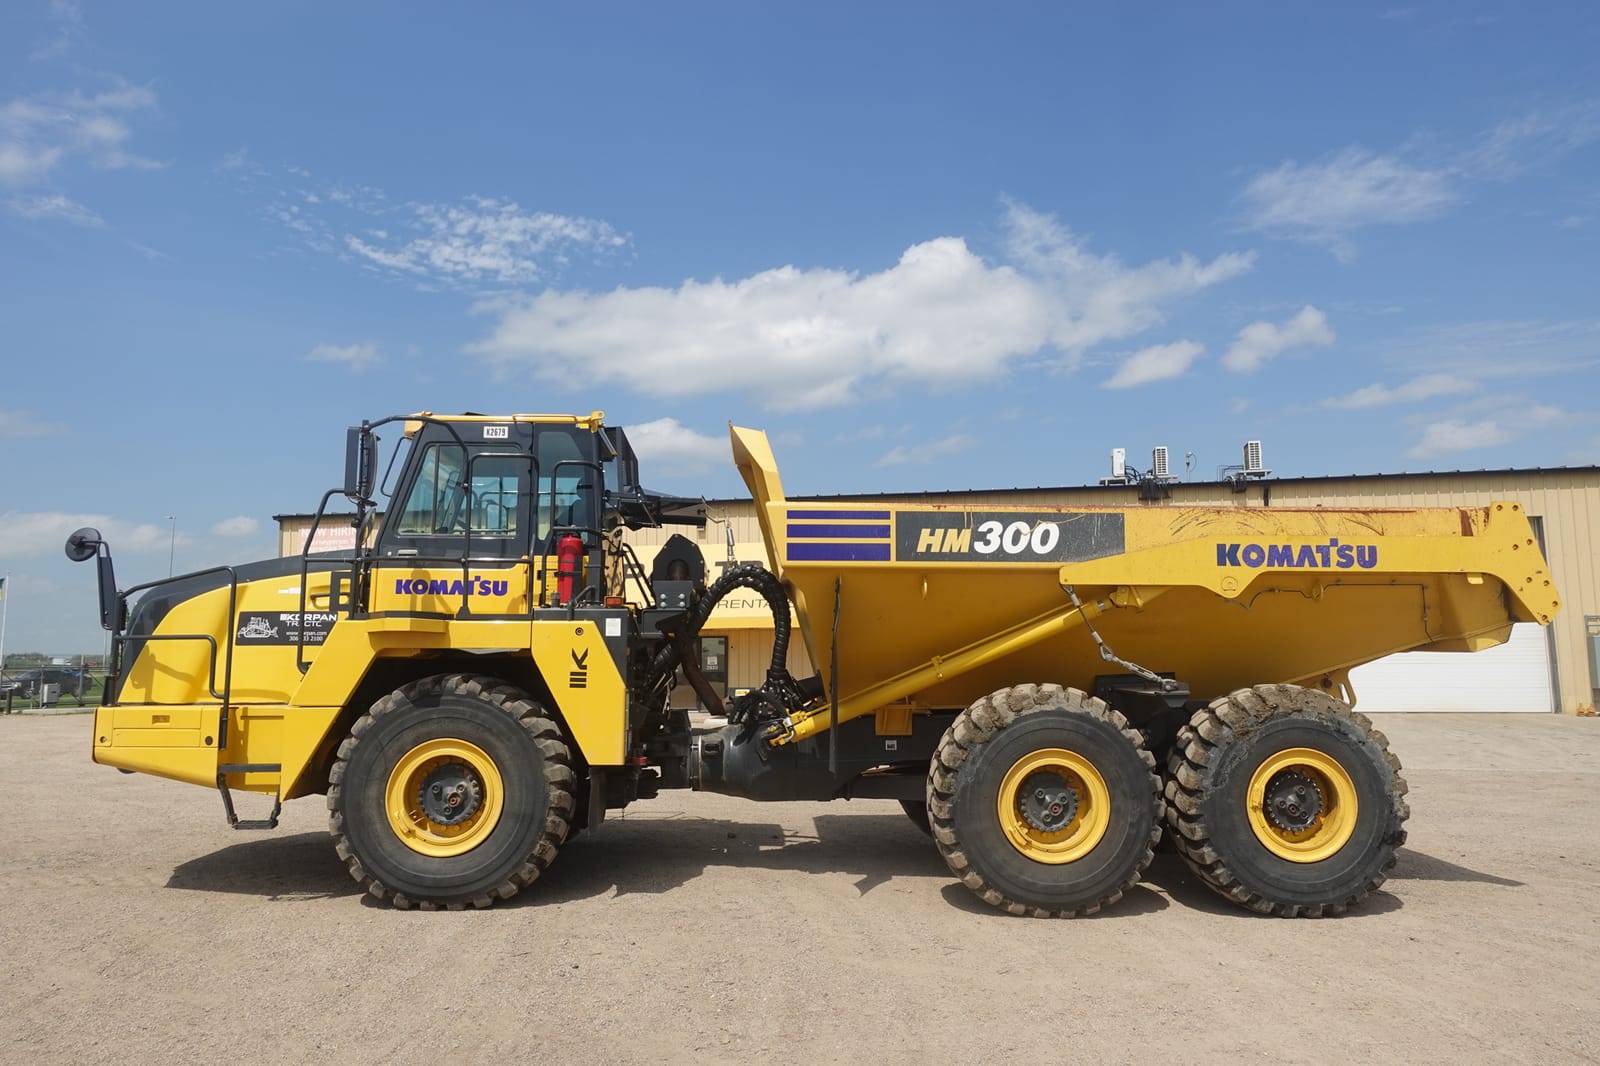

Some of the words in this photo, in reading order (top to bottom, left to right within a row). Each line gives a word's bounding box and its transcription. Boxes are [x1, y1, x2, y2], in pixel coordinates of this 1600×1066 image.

[486, 428, 506, 437] K2679
[301, 528, 325, 536] NW
[330, 526, 357, 536] HIRIN
[1216, 538, 1377, 568] KOMATSU
[395, 576, 508, 596] KOMATSU
